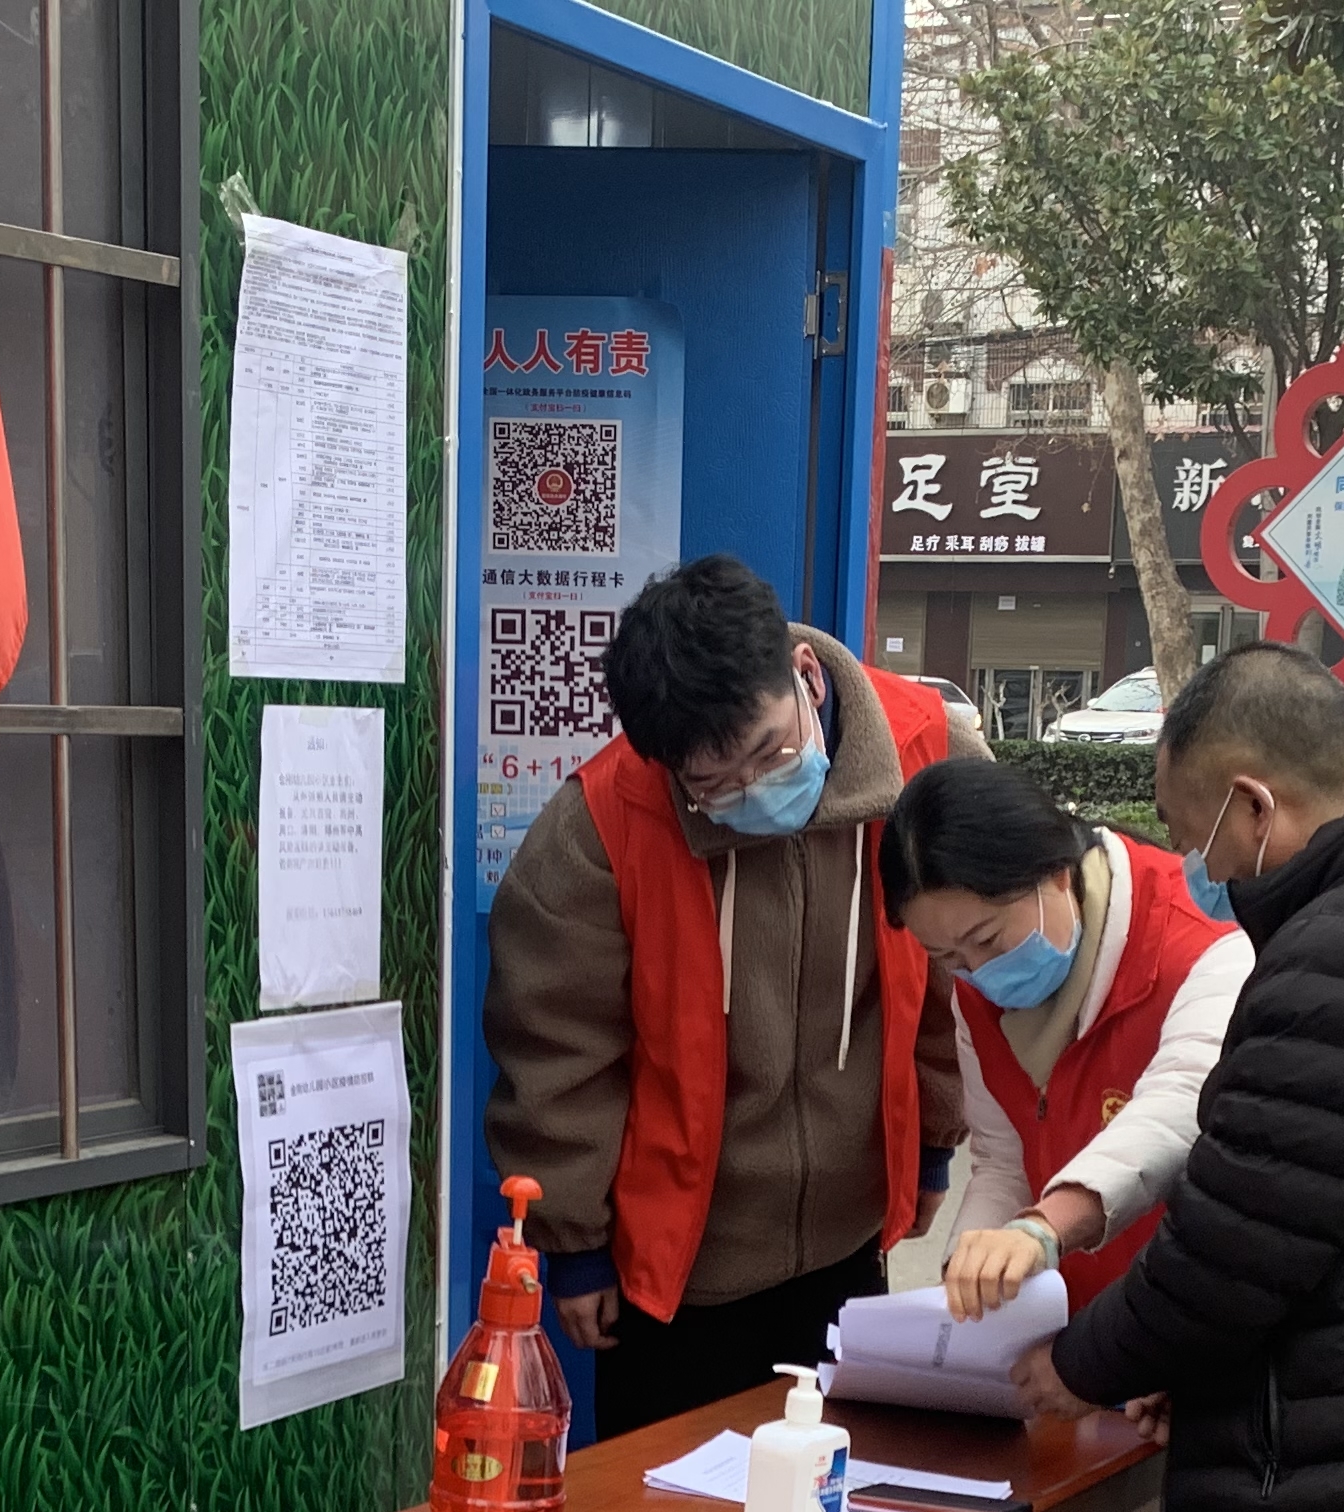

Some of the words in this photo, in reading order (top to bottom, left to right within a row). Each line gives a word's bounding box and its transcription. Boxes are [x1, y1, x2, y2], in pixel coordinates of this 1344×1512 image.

[484, 328, 651, 378] 人人有责
[910, 534, 941, 552] 足疗
[945, 534, 975, 552] 采耳
[979, 535, 1010, 552] 刮痧
[1015, 535, 1046, 552] 拔罐
[482, 568, 625, 588] 通信大数据行程卡
